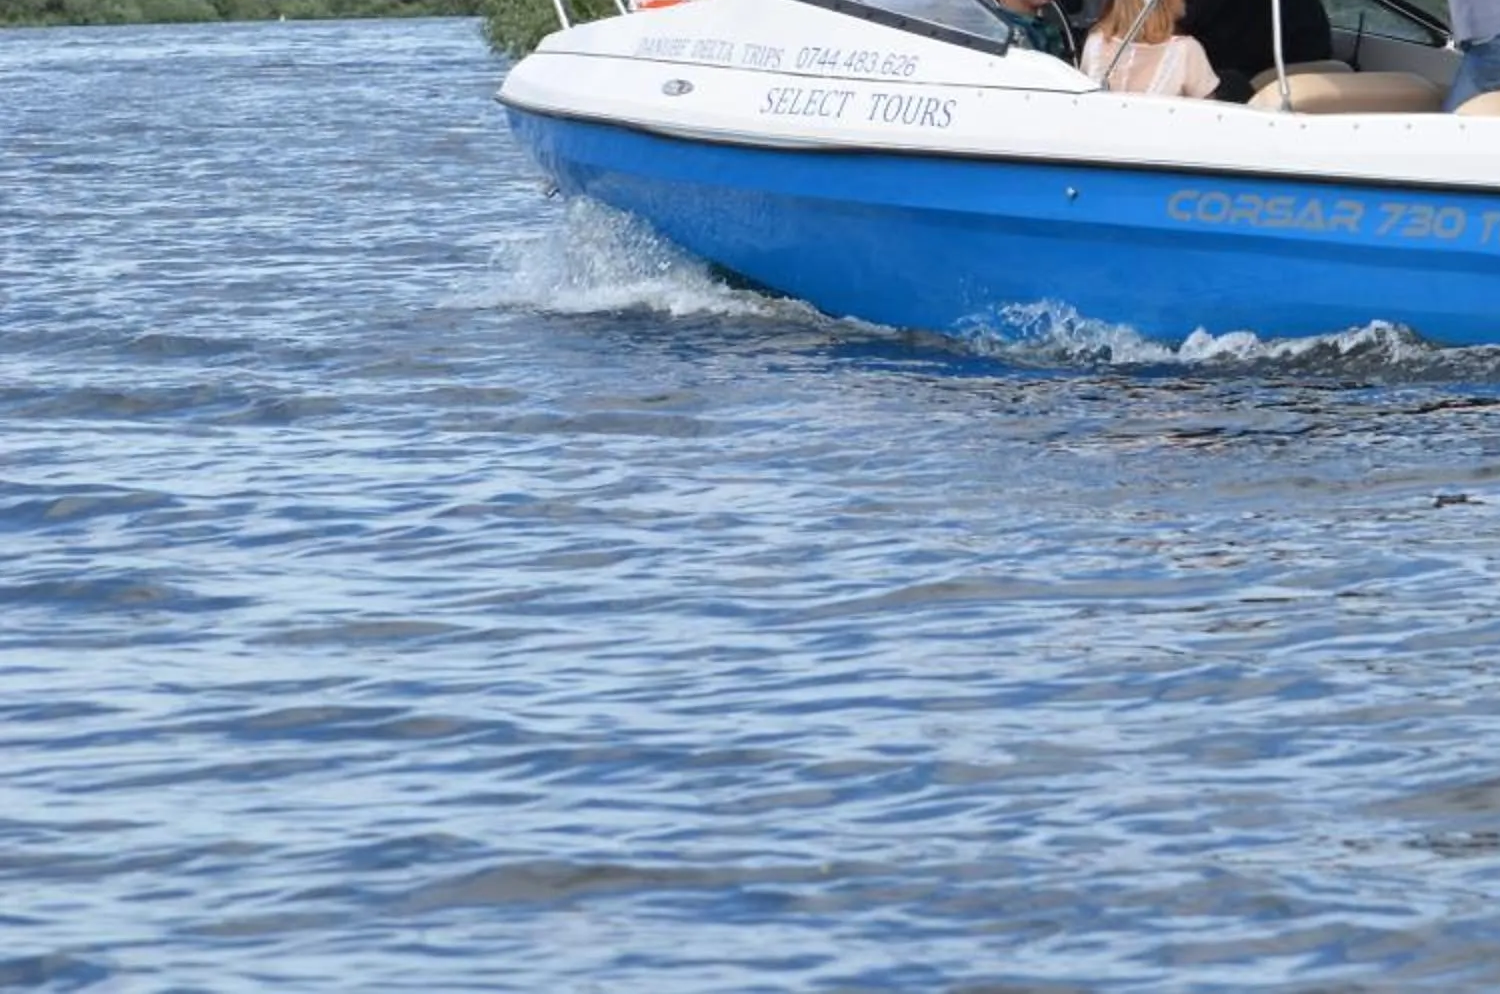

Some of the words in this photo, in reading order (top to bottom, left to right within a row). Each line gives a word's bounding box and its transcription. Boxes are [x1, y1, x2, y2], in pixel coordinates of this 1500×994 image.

[741, 42, 785, 68] TRIPS
[760, 86, 855, 119] SELECT
[868, 92, 957, 128] TOURS
[1167, 188, 1365, 234] CORSAR
[1375, 201, 1466, 239] 730
